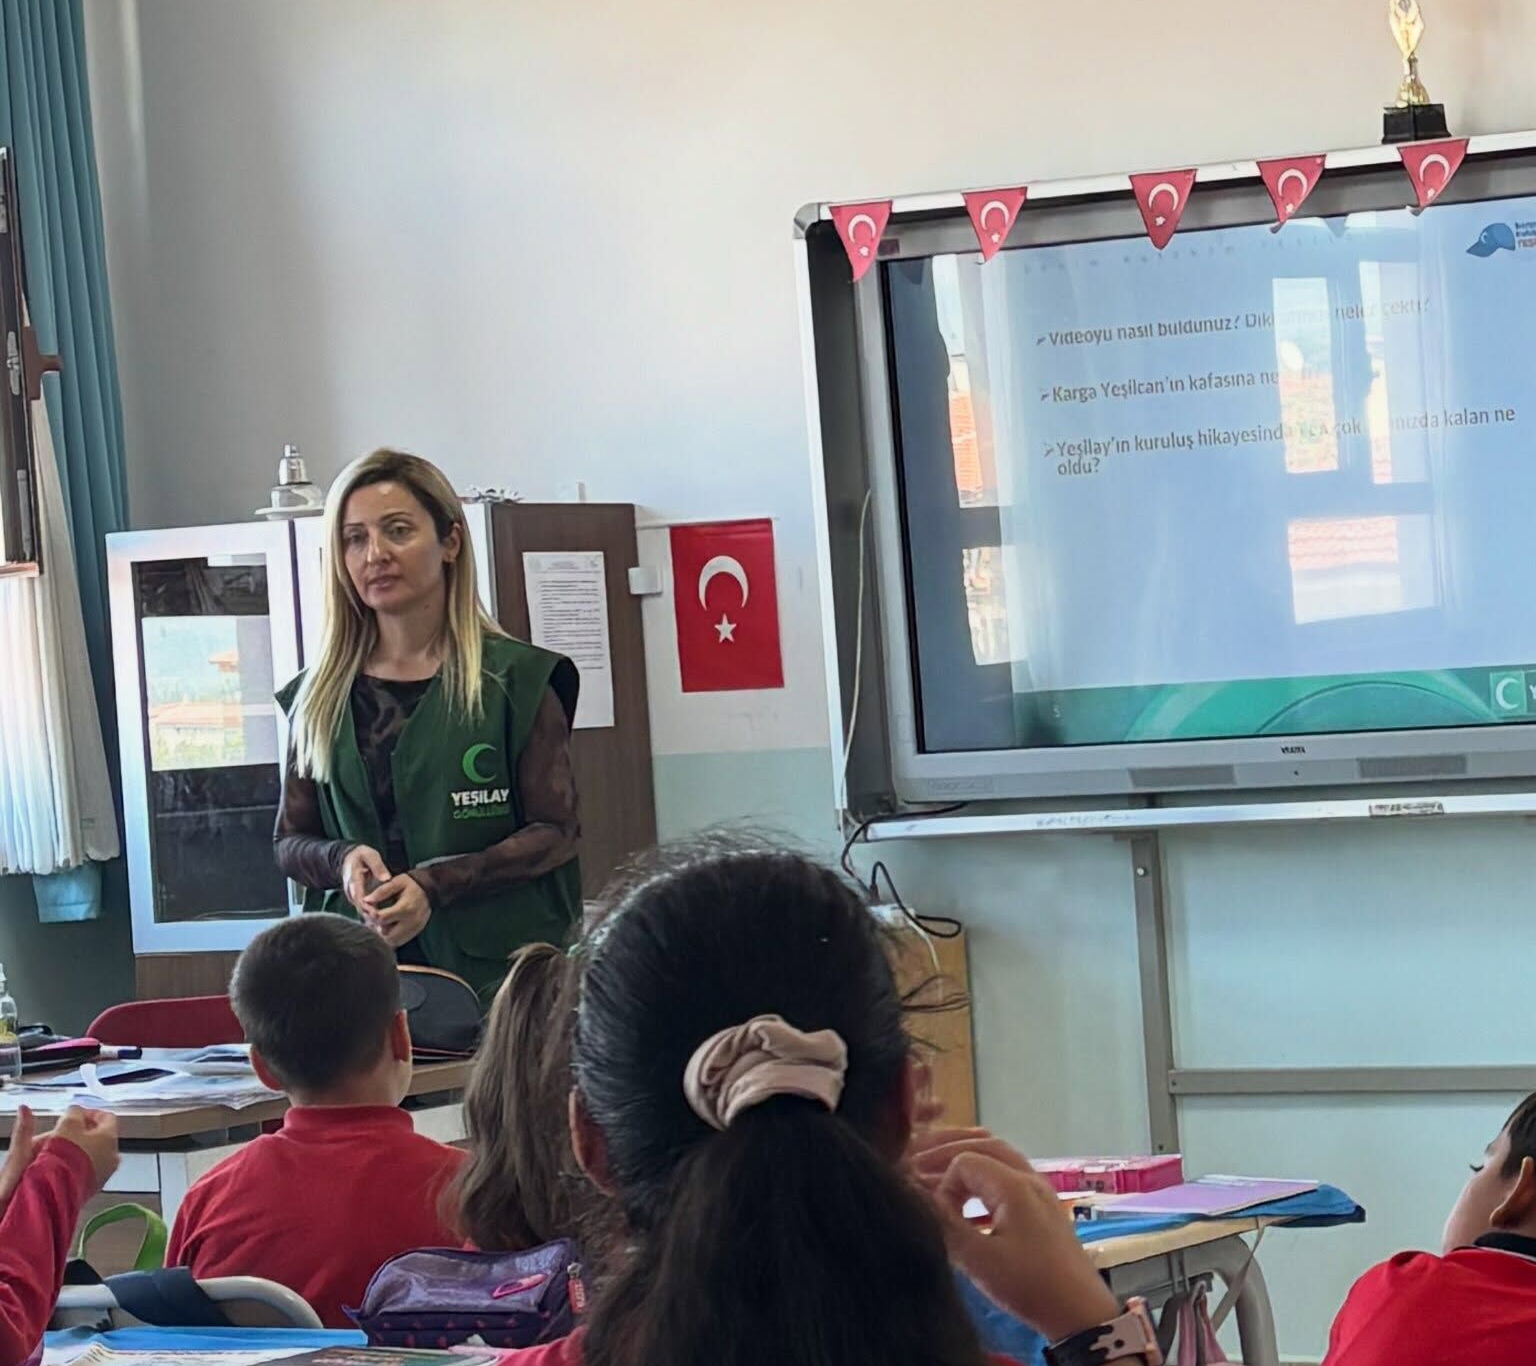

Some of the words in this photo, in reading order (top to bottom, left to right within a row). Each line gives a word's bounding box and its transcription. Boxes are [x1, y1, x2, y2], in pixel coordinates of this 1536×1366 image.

[1117, 322, 1154, 341] nasıl
[1052, 384, 1098, 404] Karga
[1188, 371, 1256, 392] kafasına
[1134, 431, 1194, 452] kuruluş
[1198, 422, 1289, 447] hikayesind
[1443, 404, 1490, 427] kalan
[1494, 408, 1517, 423] ne
[1057, 457, 1101, 477] oldu?
